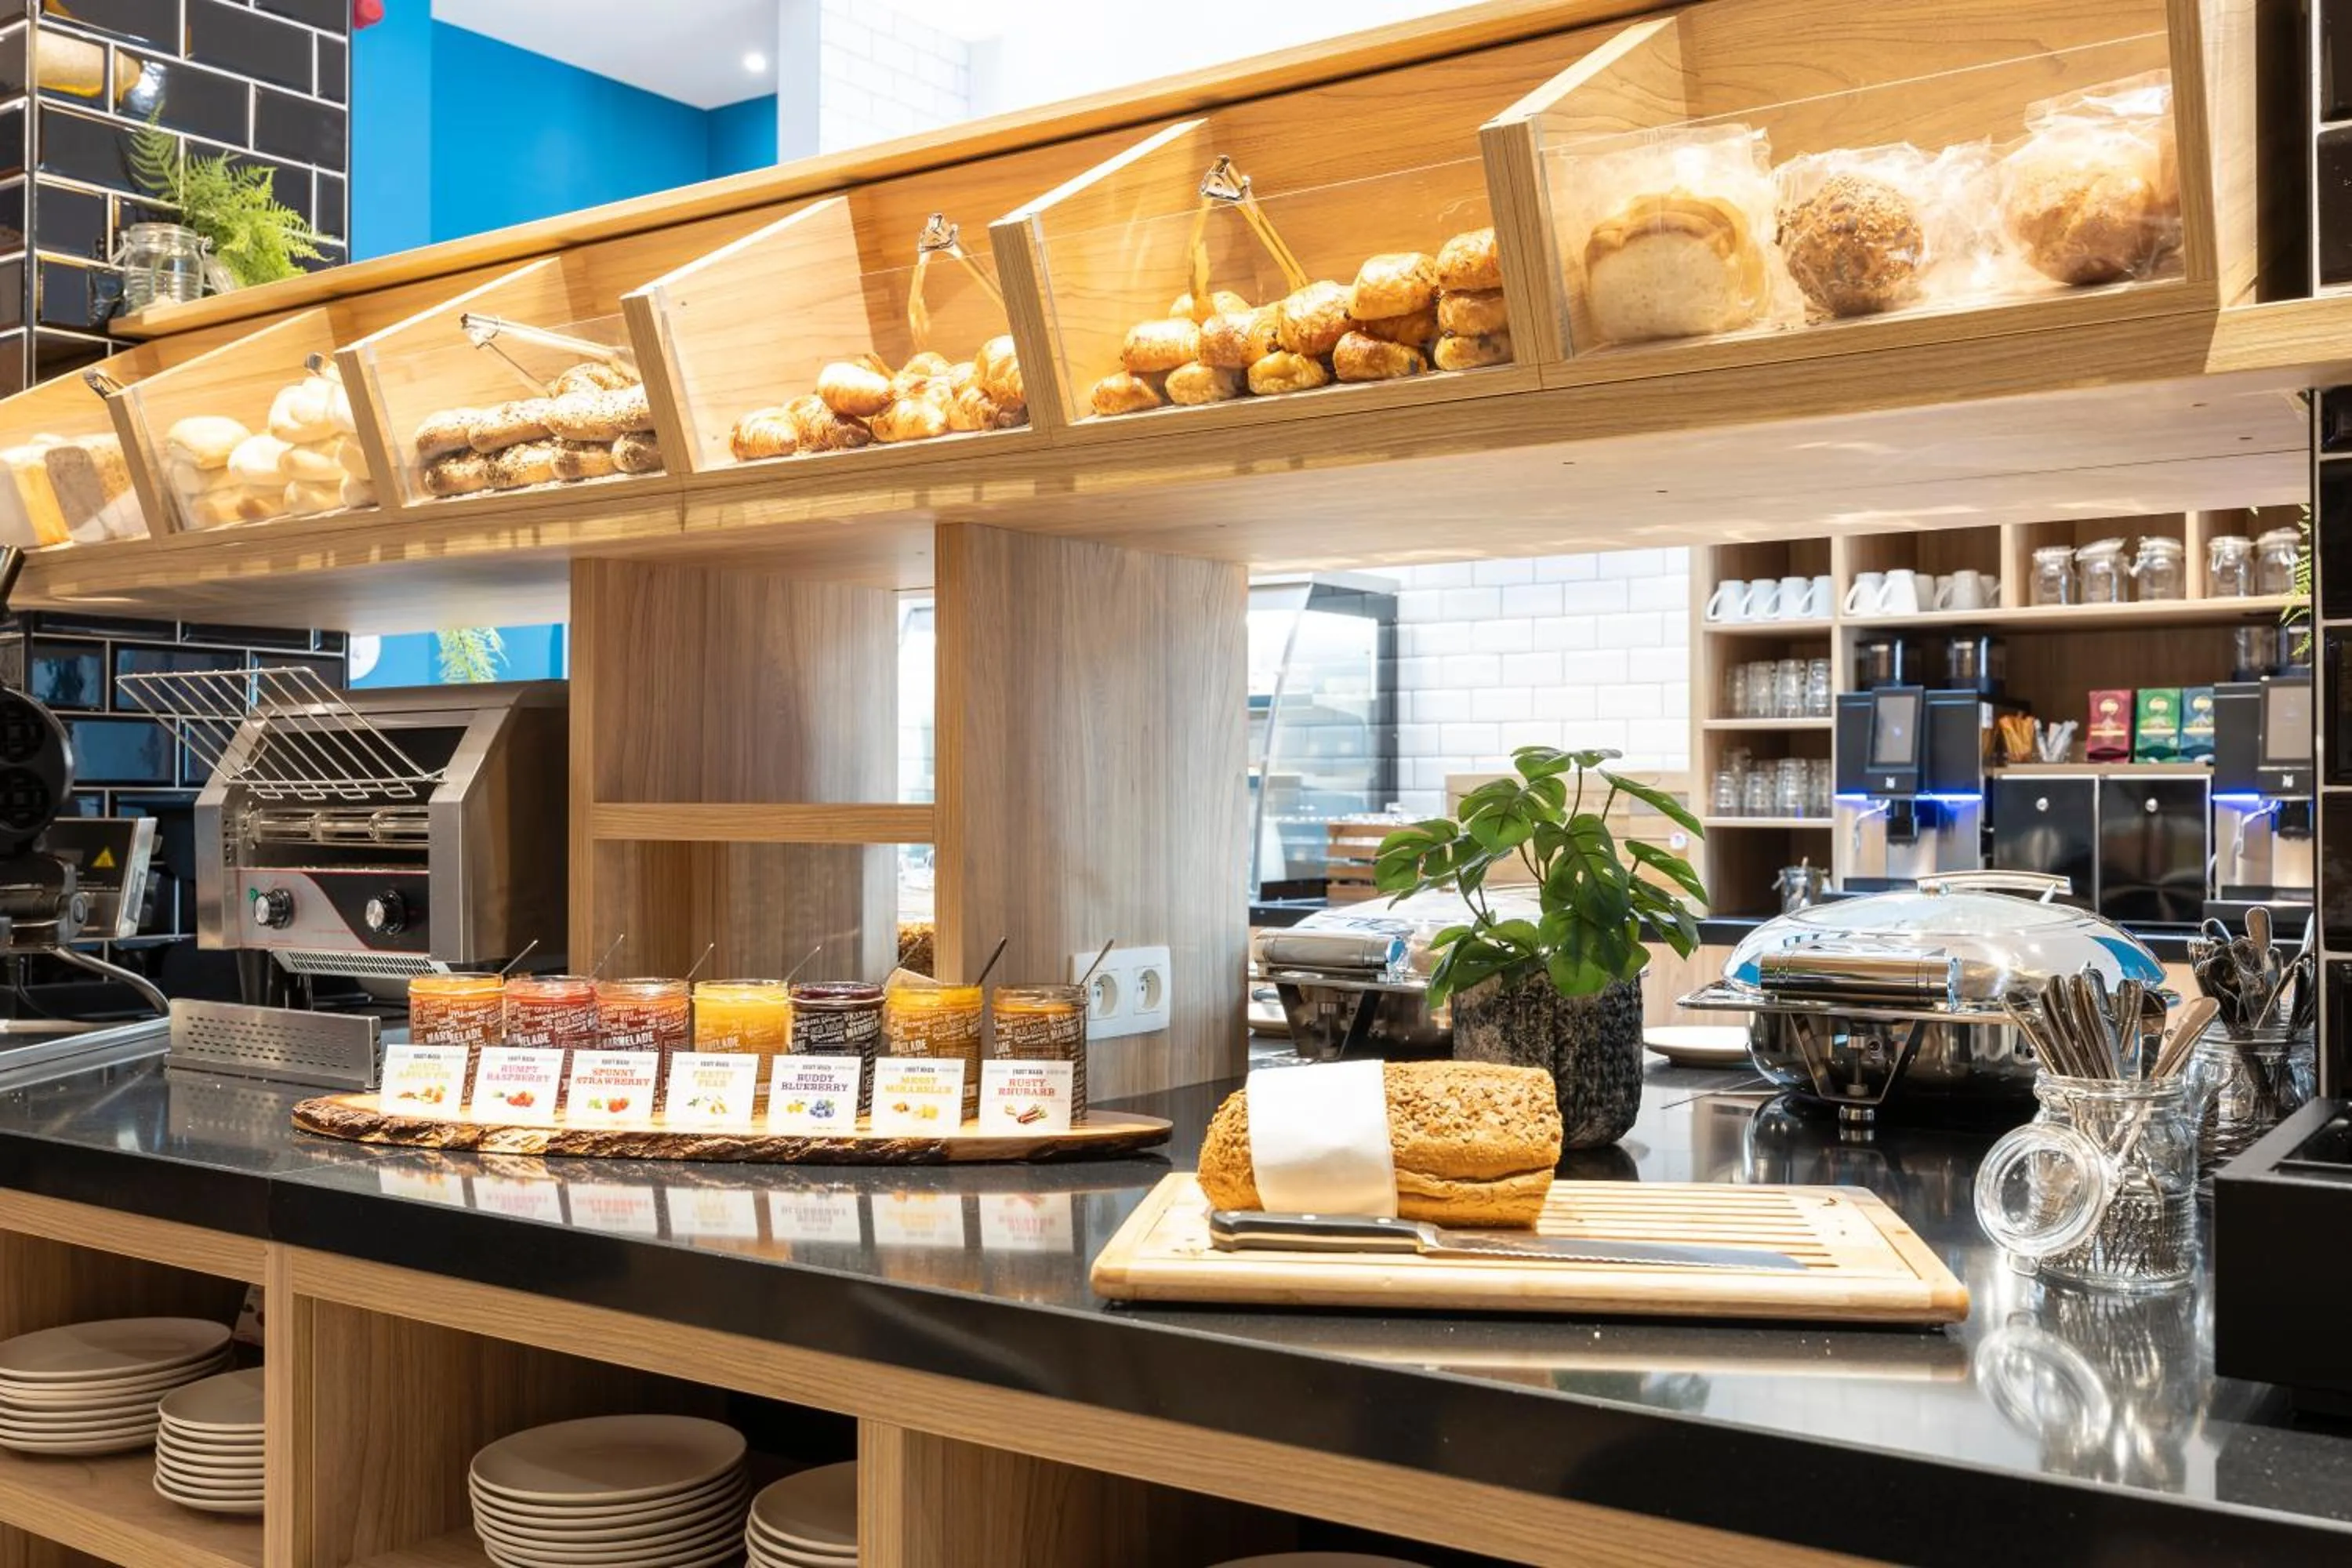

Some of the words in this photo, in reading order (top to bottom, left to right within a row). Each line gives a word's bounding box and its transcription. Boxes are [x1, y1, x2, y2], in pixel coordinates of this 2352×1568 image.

[500, 1065, 539, 1073] RUMPY
[591, 1067, 637, 1076] SPUNNY
[486, 1073, 551, 1083] RASPBERRY
[575, 1076, 651, 1087] STRAWBERRY
[797, 1073, 835, 1083] BUDDY
[1008, 1078, 1047, 1087] RUSTY
[780, 1082, 849, 1092] BLUEBERRY
[997, 1087, 1055, 1097] RHUBARB
